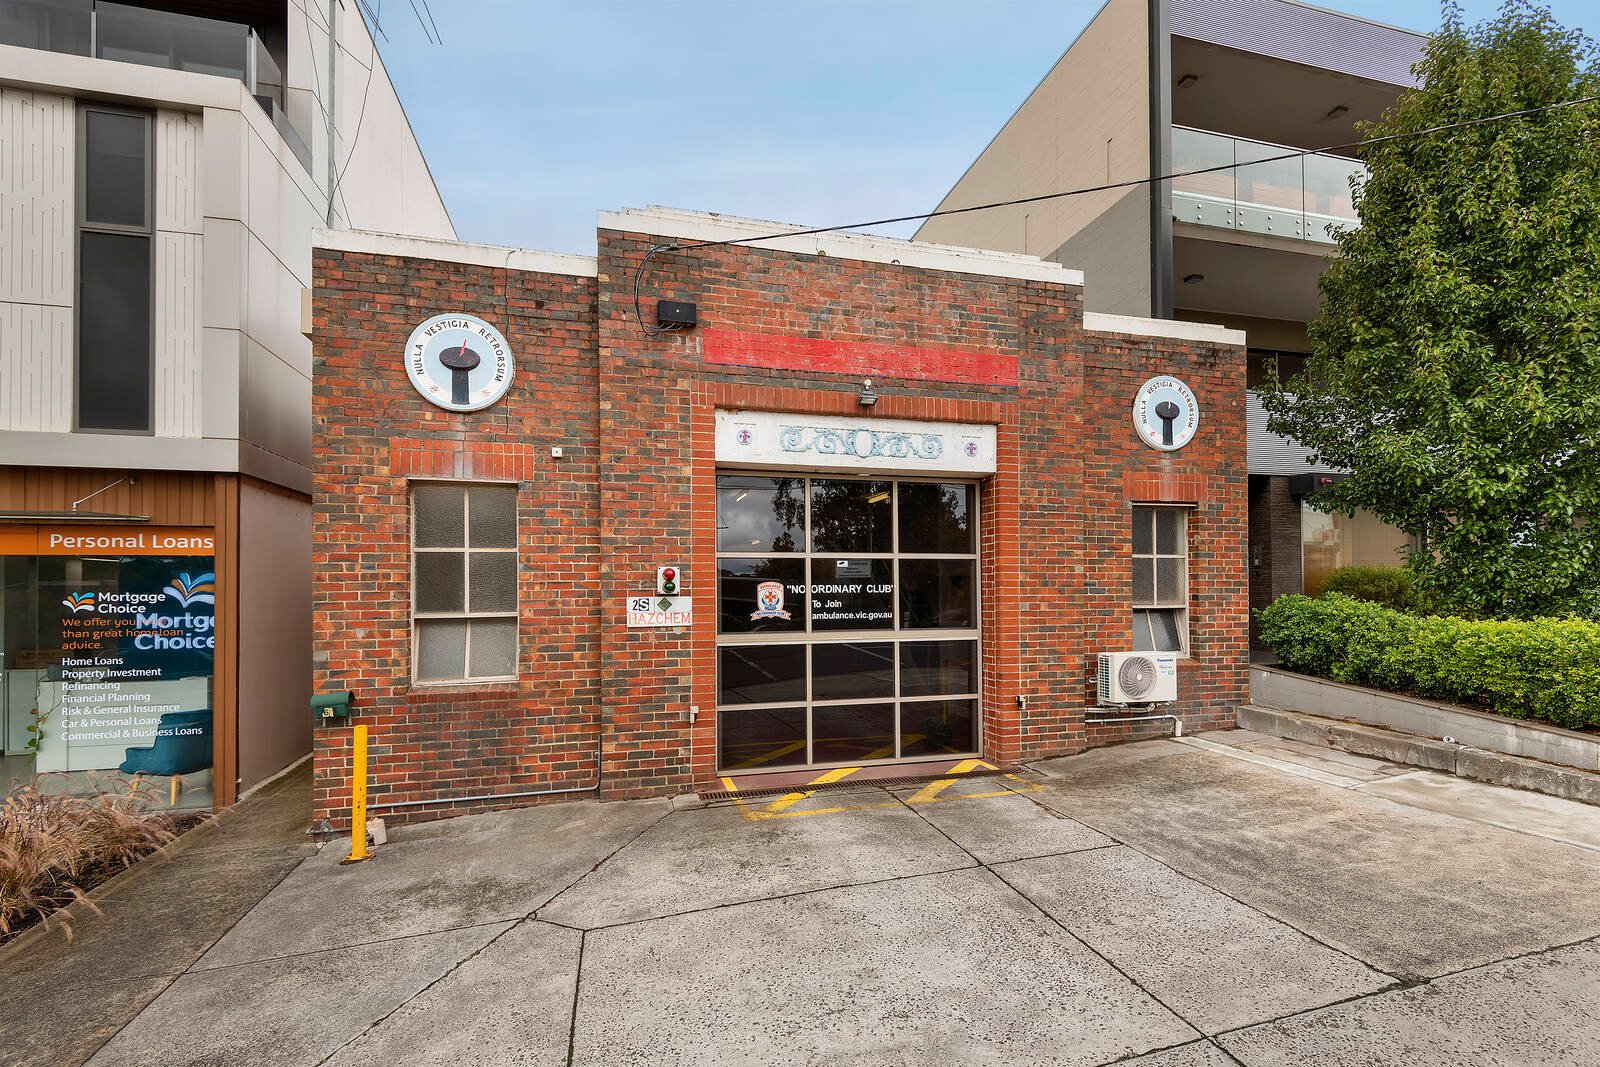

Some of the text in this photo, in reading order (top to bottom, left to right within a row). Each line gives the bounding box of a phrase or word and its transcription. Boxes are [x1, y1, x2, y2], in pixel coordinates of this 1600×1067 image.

[413, 320, 506, 382] NULLA VESTIGIA RETRORSUM
[50, 533, 214, 549] Personal Loans
[811, 584, 863, 594] ORDINARY
[98, 592, 166, 604] Mortgage
[812, 599, 842, 608] To Join
[98, 603, 147, 614] Choice
[628, 612, 691, 625] HAZCHEM
[811, 611, 893, 621] ambulance.vic.gov.au
[62, 618, 80, 627] We
[83, 617, 112, 627] offer
[114, 619, 136, 628] you
[62, 630, 90, 638] than
[92, 629, 123, 640] great
[62, 640, 104, 650] advice.
[62, 656, 123, 666] Home Loans
[62, 668, 162, 680] Property Investment
[62, 681, 121, 691] Refinancing
[61, 693, 151, 703] Financial Planning
[62, 704, 180, 716] Risk & General Insurance
[61, 716, 162, 729] Car & Personal Loans
[61, 727, 203, 741] Commercial & Business Loans
